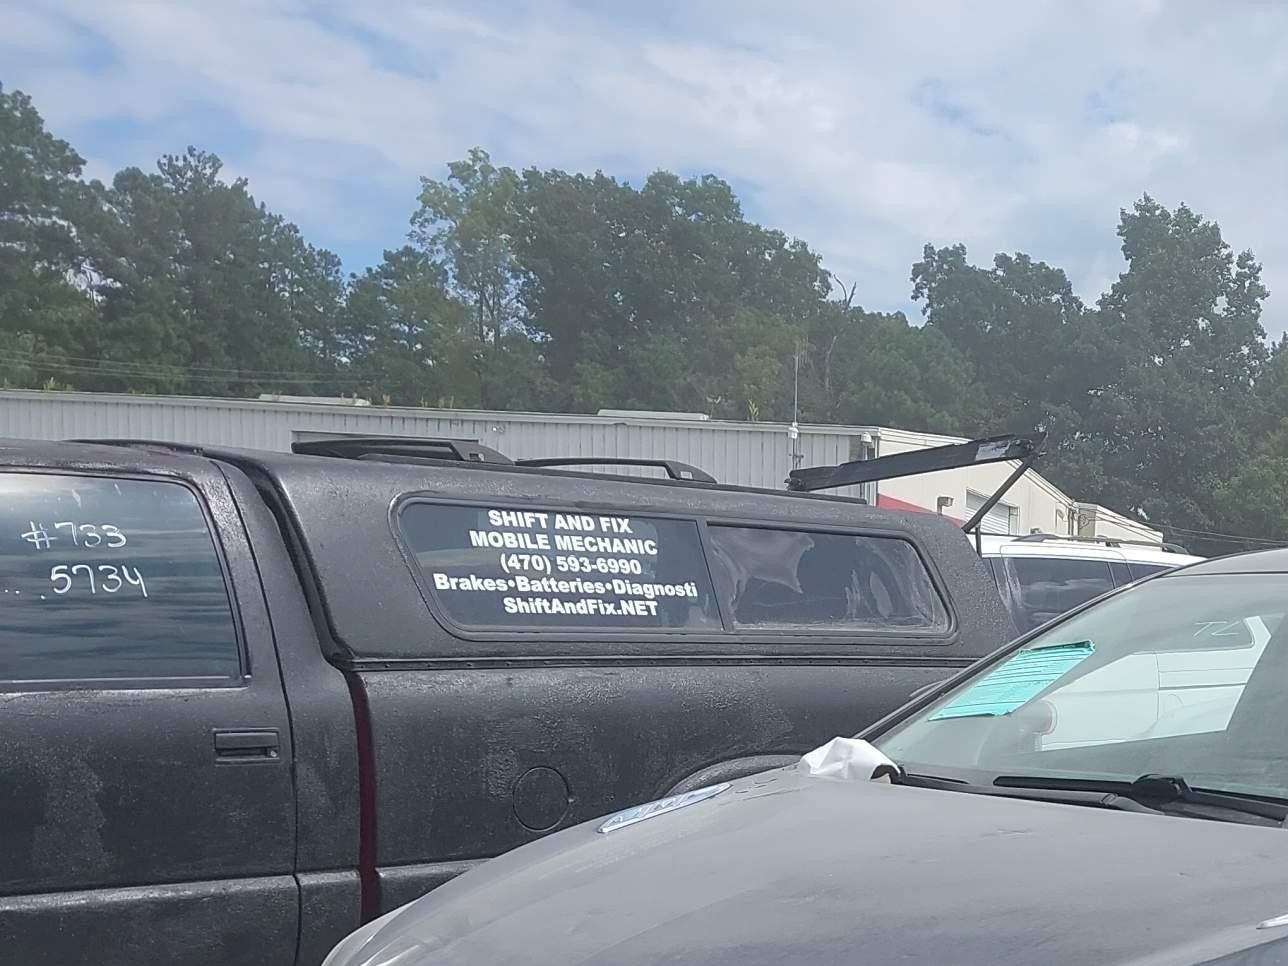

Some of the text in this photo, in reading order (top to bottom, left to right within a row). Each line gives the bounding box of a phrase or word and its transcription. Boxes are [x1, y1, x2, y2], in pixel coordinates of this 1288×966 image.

[487, 510, 633, 534] SHIFT AND FIX
[21, 521, 127, 549] #733
[469, 530, 658, 555] MOBILE MECHANIC
[500, 554, 642, 574] (470) 593-6990
[51, 564, 148, 597] 5734
[503, 597, 658, 616] ShiftAndFix.NET
